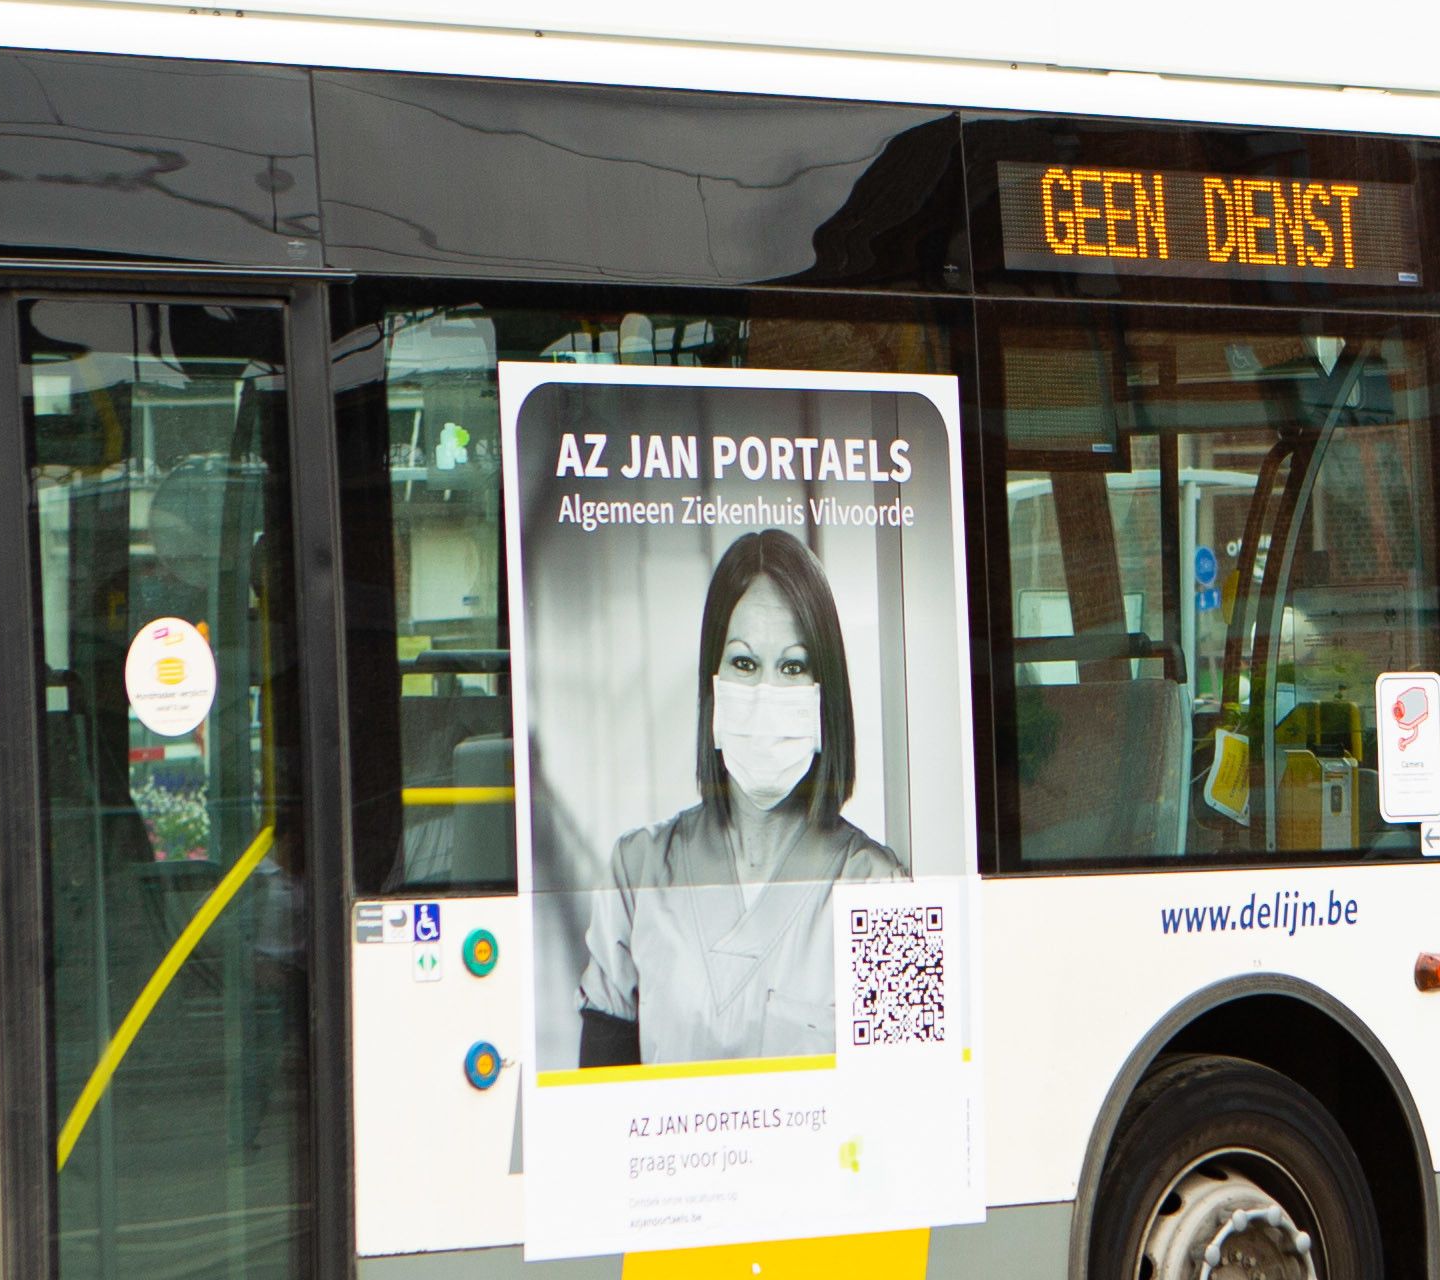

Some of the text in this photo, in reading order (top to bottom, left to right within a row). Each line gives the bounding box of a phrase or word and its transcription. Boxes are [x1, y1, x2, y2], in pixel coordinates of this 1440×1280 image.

[1042, 168, 1359, 268] GEEN DIENST
[556, 433, 912, 482] AZ JAN PORTAELS
[559, 494, 914, 532] Algemeen Ziekenhuis Vilvoorde
[1161, 890, 1358, 937] www.delijn.be
[629, 1106, 828, 1137] AZ JAN PORTAELS zorgt
[629, 1146, 753, 1179] graag voor jou.
